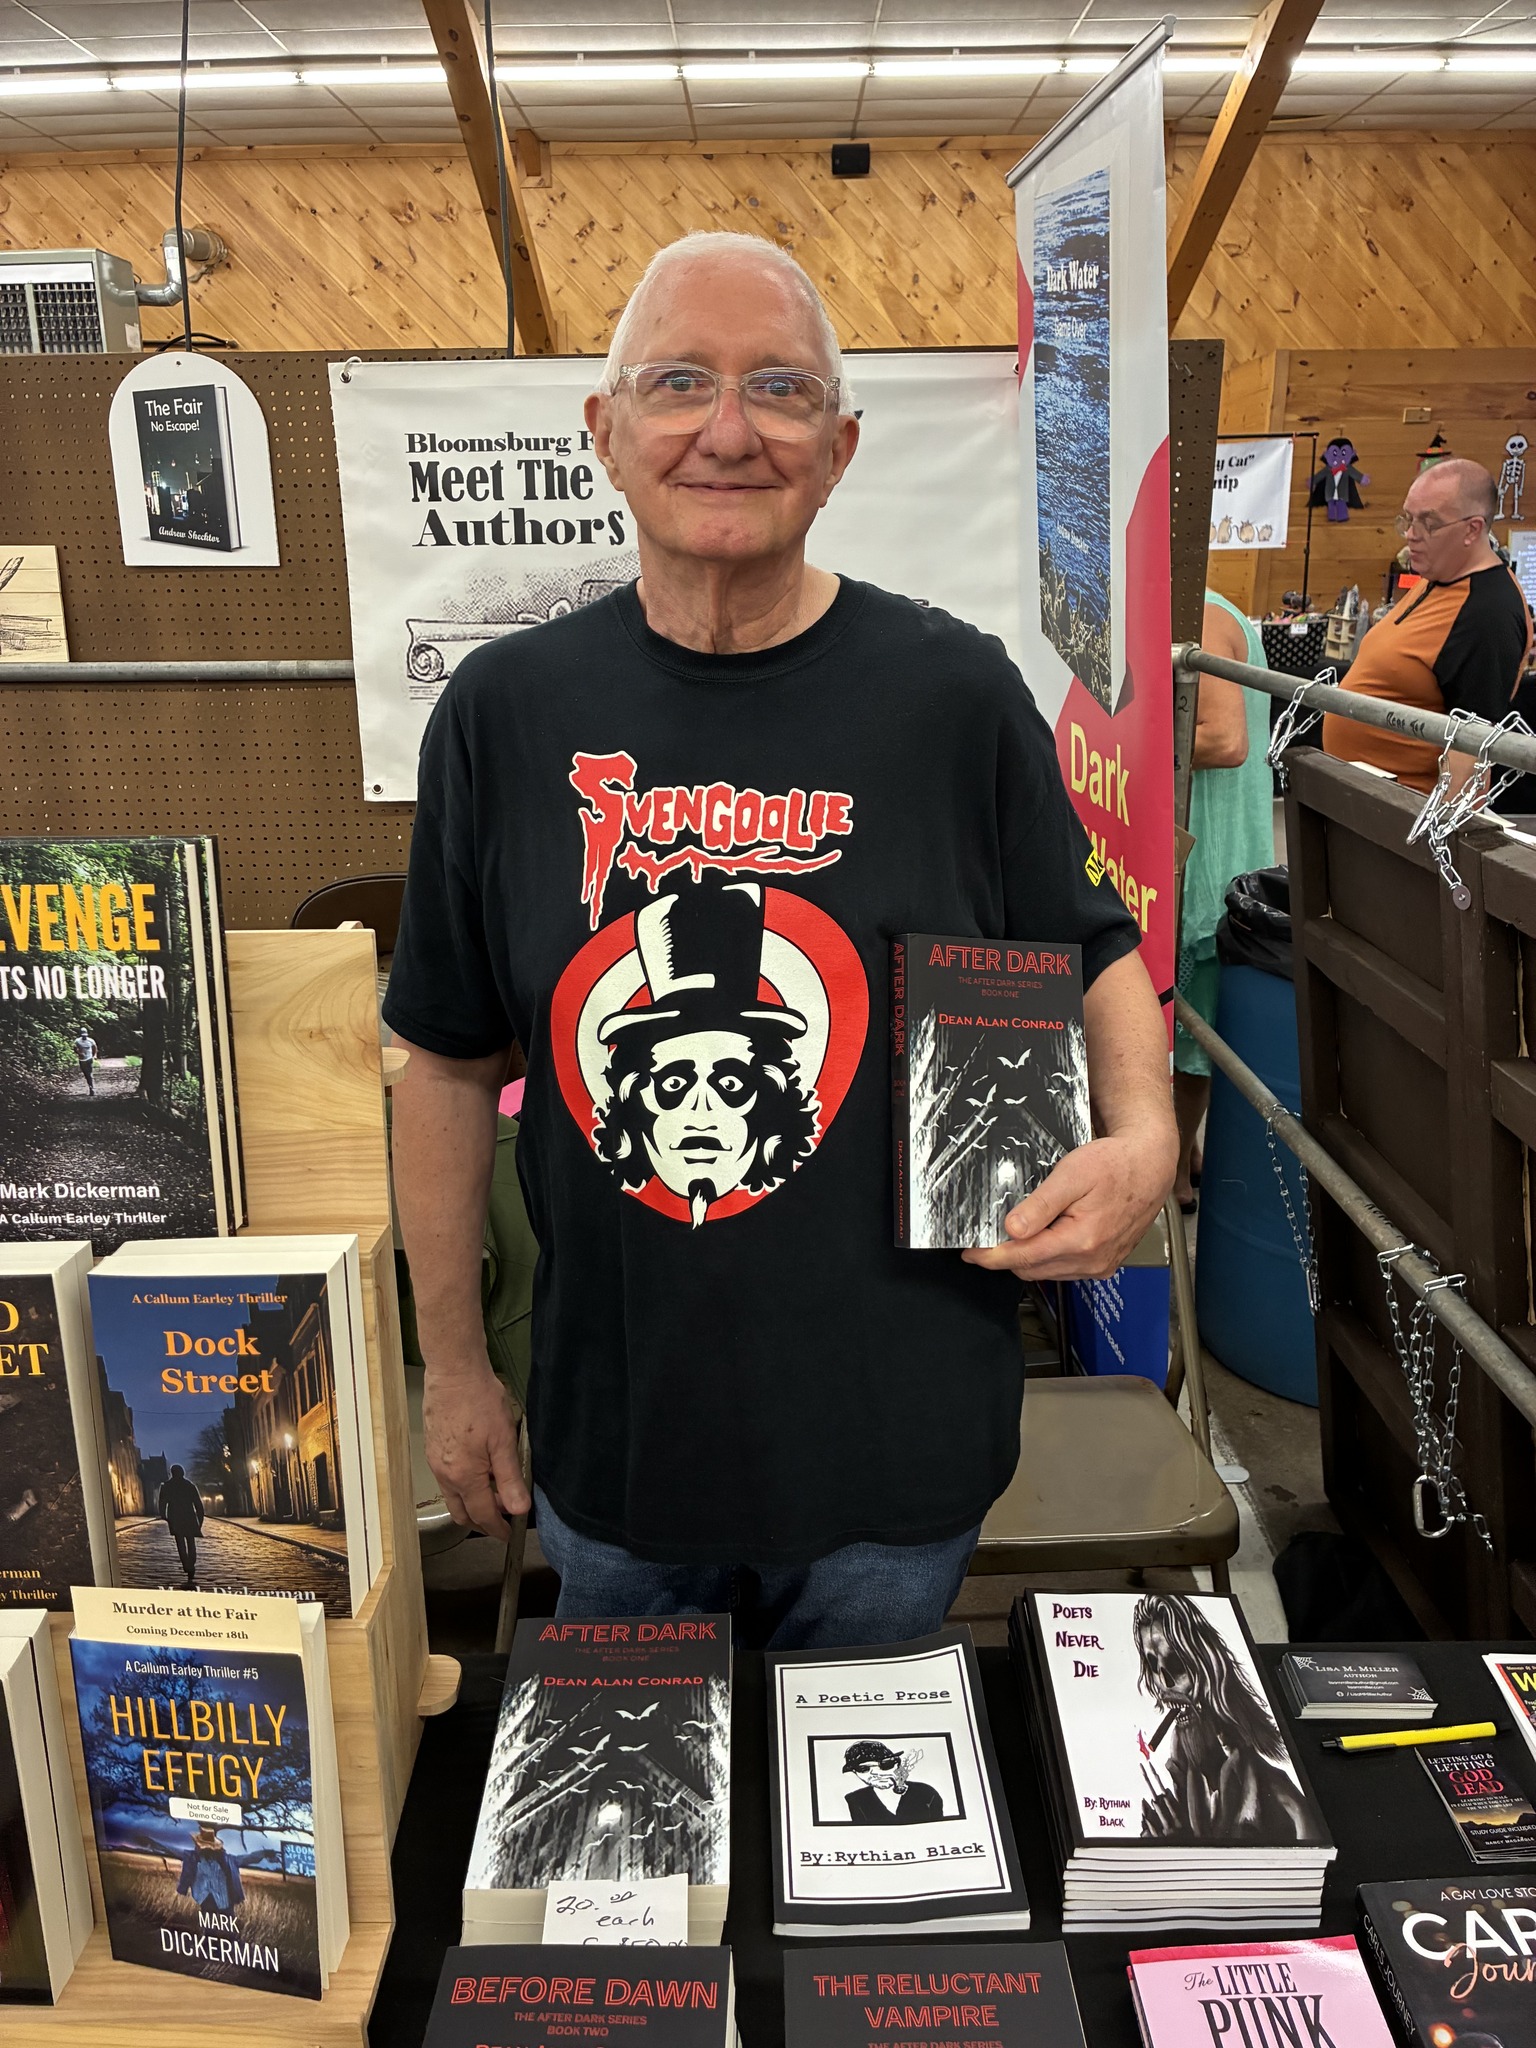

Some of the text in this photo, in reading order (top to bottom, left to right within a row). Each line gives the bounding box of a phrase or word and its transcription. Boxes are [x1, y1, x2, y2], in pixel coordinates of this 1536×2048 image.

[1069, 259, 1099, 290] Water
[145, 398, 203, 416] The Fair
[151, 420, 201, 433] No Escape!
[404, 431, 572, 457] Bloomsburg
[408, 459, 594, 502] Meet The
[158, 526, 187, 539] Andrew
[412, 507, 626, 547] Authors
[1070, 721, 1130, 827] Dark
[568, 750, 853, 931] SVENGOOLIE
[0, 884, 161, 952] VENGE
[928, 943, 1072, 976] AFTER DARK
[33, 965, 67, 1000] NO
[73, 965, 167, 1000] LONGER
[958, 976, 1043, 989] THE AFTER DARK SERIES
[893, 943, 905, 1056] AFTER DARK
[982, 989, 1019, 998] BOOK ONE
[0, 1182, 160, 1199] Mark Dickerman
[12, 1213, 62, 1224] Callum
[66, 1213, 110, 1227] Earley
[114, 1212, 167, 1225] Thriller
[132, 1292, 288, 1305] A Callum Earley Thriller
[163, 1328, 261, 1356] Dock
[161, 1367, 274, 1393] Street
[9, 1589, 58, 1600] Thriller
[112, 1602, 258, 1621] Murder at the Fair
[1052, 1602, 1093, 1619] POETS
[126, 1625, 249, 1640] Coming December 18th
[538, 1622, 717, 1643] AFTER DARK
[1055, 1631, 1105, 1650] NEVER
[126, 1660, 259, 1680] A Callum Earley Thriller #5
[1073, 1660, 1099, 1678] DIE
[795, 1690, 951, 1704] A Poetic Prose
[110, 1694, 286, 1747] HILLBILLY
[1427, 1755, 1468, 1765] LETTING
[1486, 1752, 1494, 1760] &
[1434, 1759, 1495, 1772] LETTING
[143, 1749, 264, 1799] EFFIGY
[1448, 1768, 1493, 1783] GOD
[1452, 1780, 1504, 1796] LEAD
[187, 1803, 229, 1814] Not for Sale
[189, 1811, 230, 1823] Demo Copy
[926, 1843, 985, 1858] Black
[1440, 1891, 1451, 1901] A
[1452, 1889, 1476, 1900] GAY
[1478, 1888, 1514, 1899] LOVE
[199, 1911, 240, 1934] MARK
[160, 1928, 280, 1973] DICKERMAN
[813, 1972, 1042, 1996] THE RELUCTANT
[1184, 1963, 1298, 1996] The LITTLE
[451, 1977, 718, 2009] BEFORE DAWN
[1383, 1964, 1416, 2036] JOURNEY
[514, 2011, 647, 2026] THE AFTER DARK SERIES
[864, 2005, 1000, 2028] VAMPIRE
[546, 2025, 610, 2037] BOOK TWO
